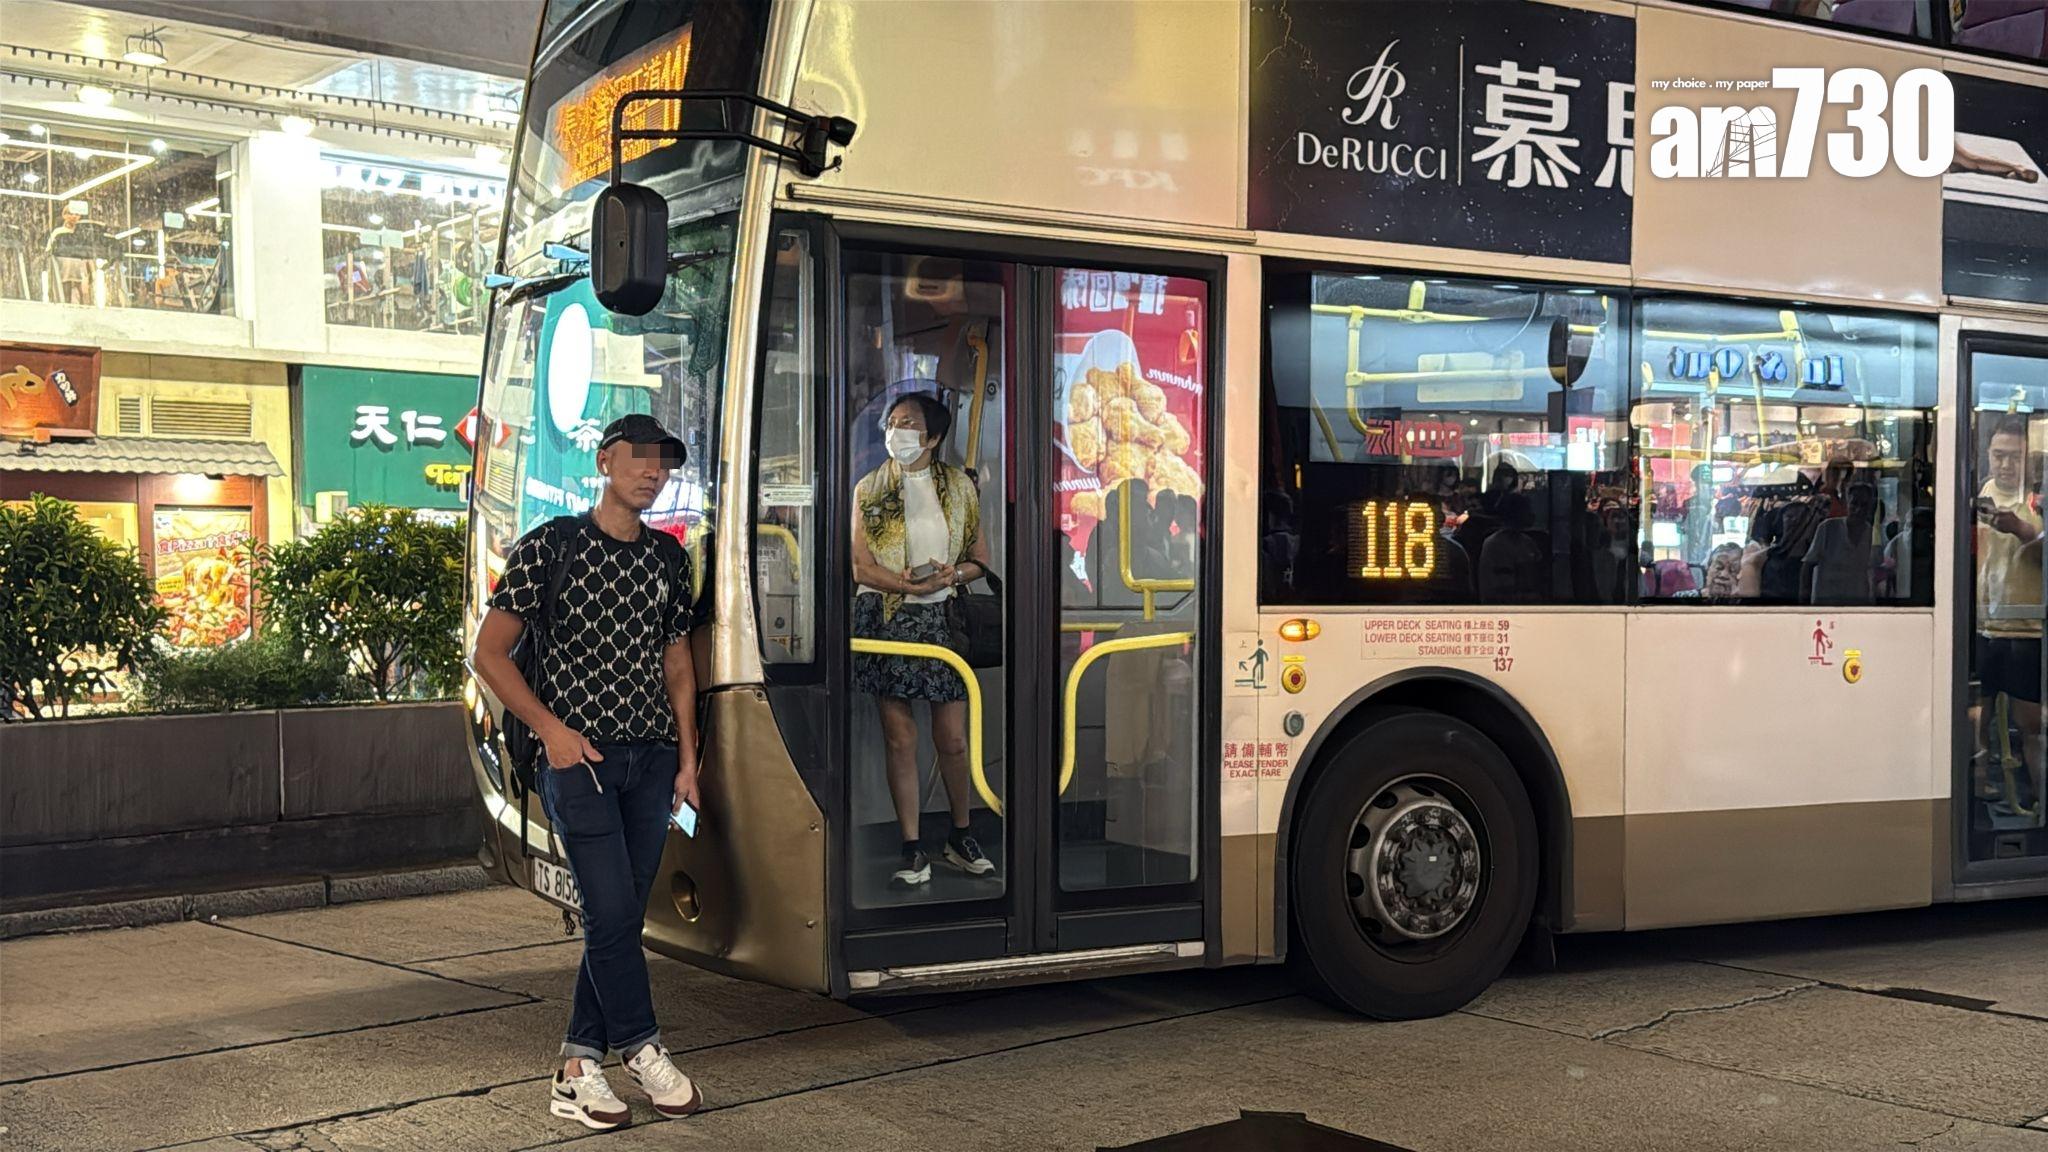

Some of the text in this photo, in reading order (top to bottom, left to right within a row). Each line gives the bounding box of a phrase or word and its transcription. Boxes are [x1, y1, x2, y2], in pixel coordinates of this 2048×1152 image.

[1297, 132, 1447, 180] DeRUCCI
[351, 405, 447, 444] 天仁
[1362, 501, 1434, 578] 118
[1364, 620, 1394, 630] UPPER
[1397, 620, 1421, 630] DECK
[1425, 620, 1462, 630] SEATING
[1498, 620, 1510, 631] 59
[1365, 633, 1397, 643] LOWER
[1400, 633, 1423, 643] DECK
[1425, 633, 1462, 643] SEATING
[1497, 633, 1508, 644] 31
[1418, 645, 1462, 656] STANDING
[1498, 646, 1510, 657] 47
[1493, 657, 1514, 672] 137
[1224, 743, 1289, 758] 請備輔幣
[1224, 759, 1289, 769] PLEASE TENDER
[1230, 768, 1282, 778] EXACT FARE
[538, 862, 580, 904] TS 8156
